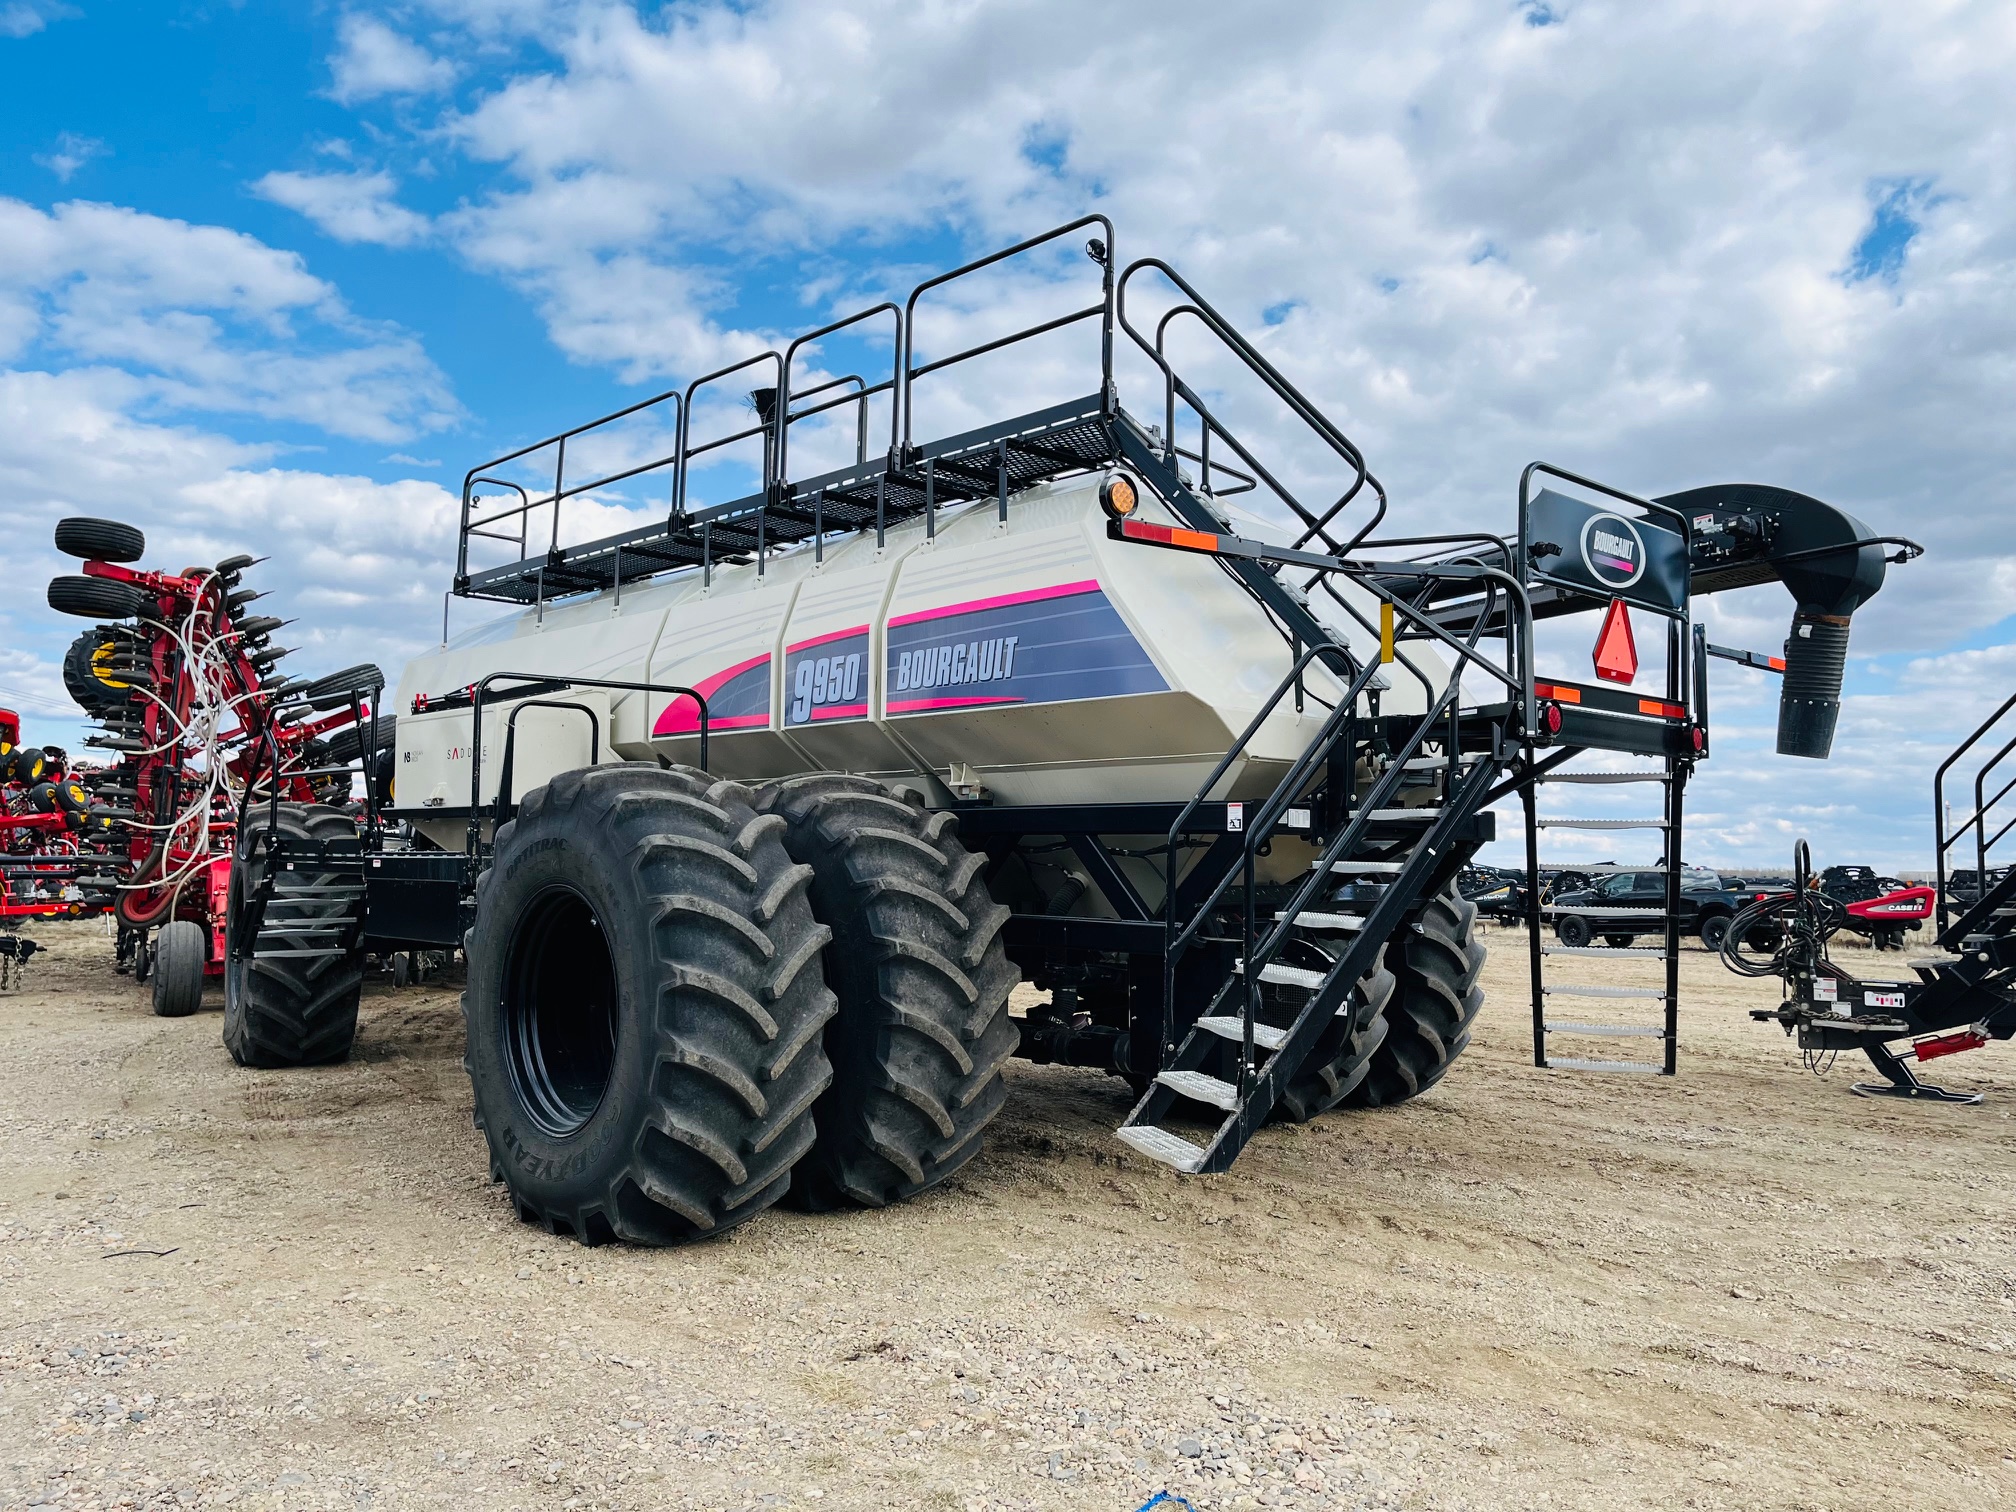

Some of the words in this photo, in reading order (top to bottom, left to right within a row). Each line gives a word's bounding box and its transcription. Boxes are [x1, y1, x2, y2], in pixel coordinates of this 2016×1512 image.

[1593, 530, 1634, 560] BOURGAULT
[896, 636, 1018, 690] BOURGAULT
[793, 654, 860, 722] 9950
[447, 746, 487, 760] SADDE
[506, 838, 568, 880] OPTITRAC
